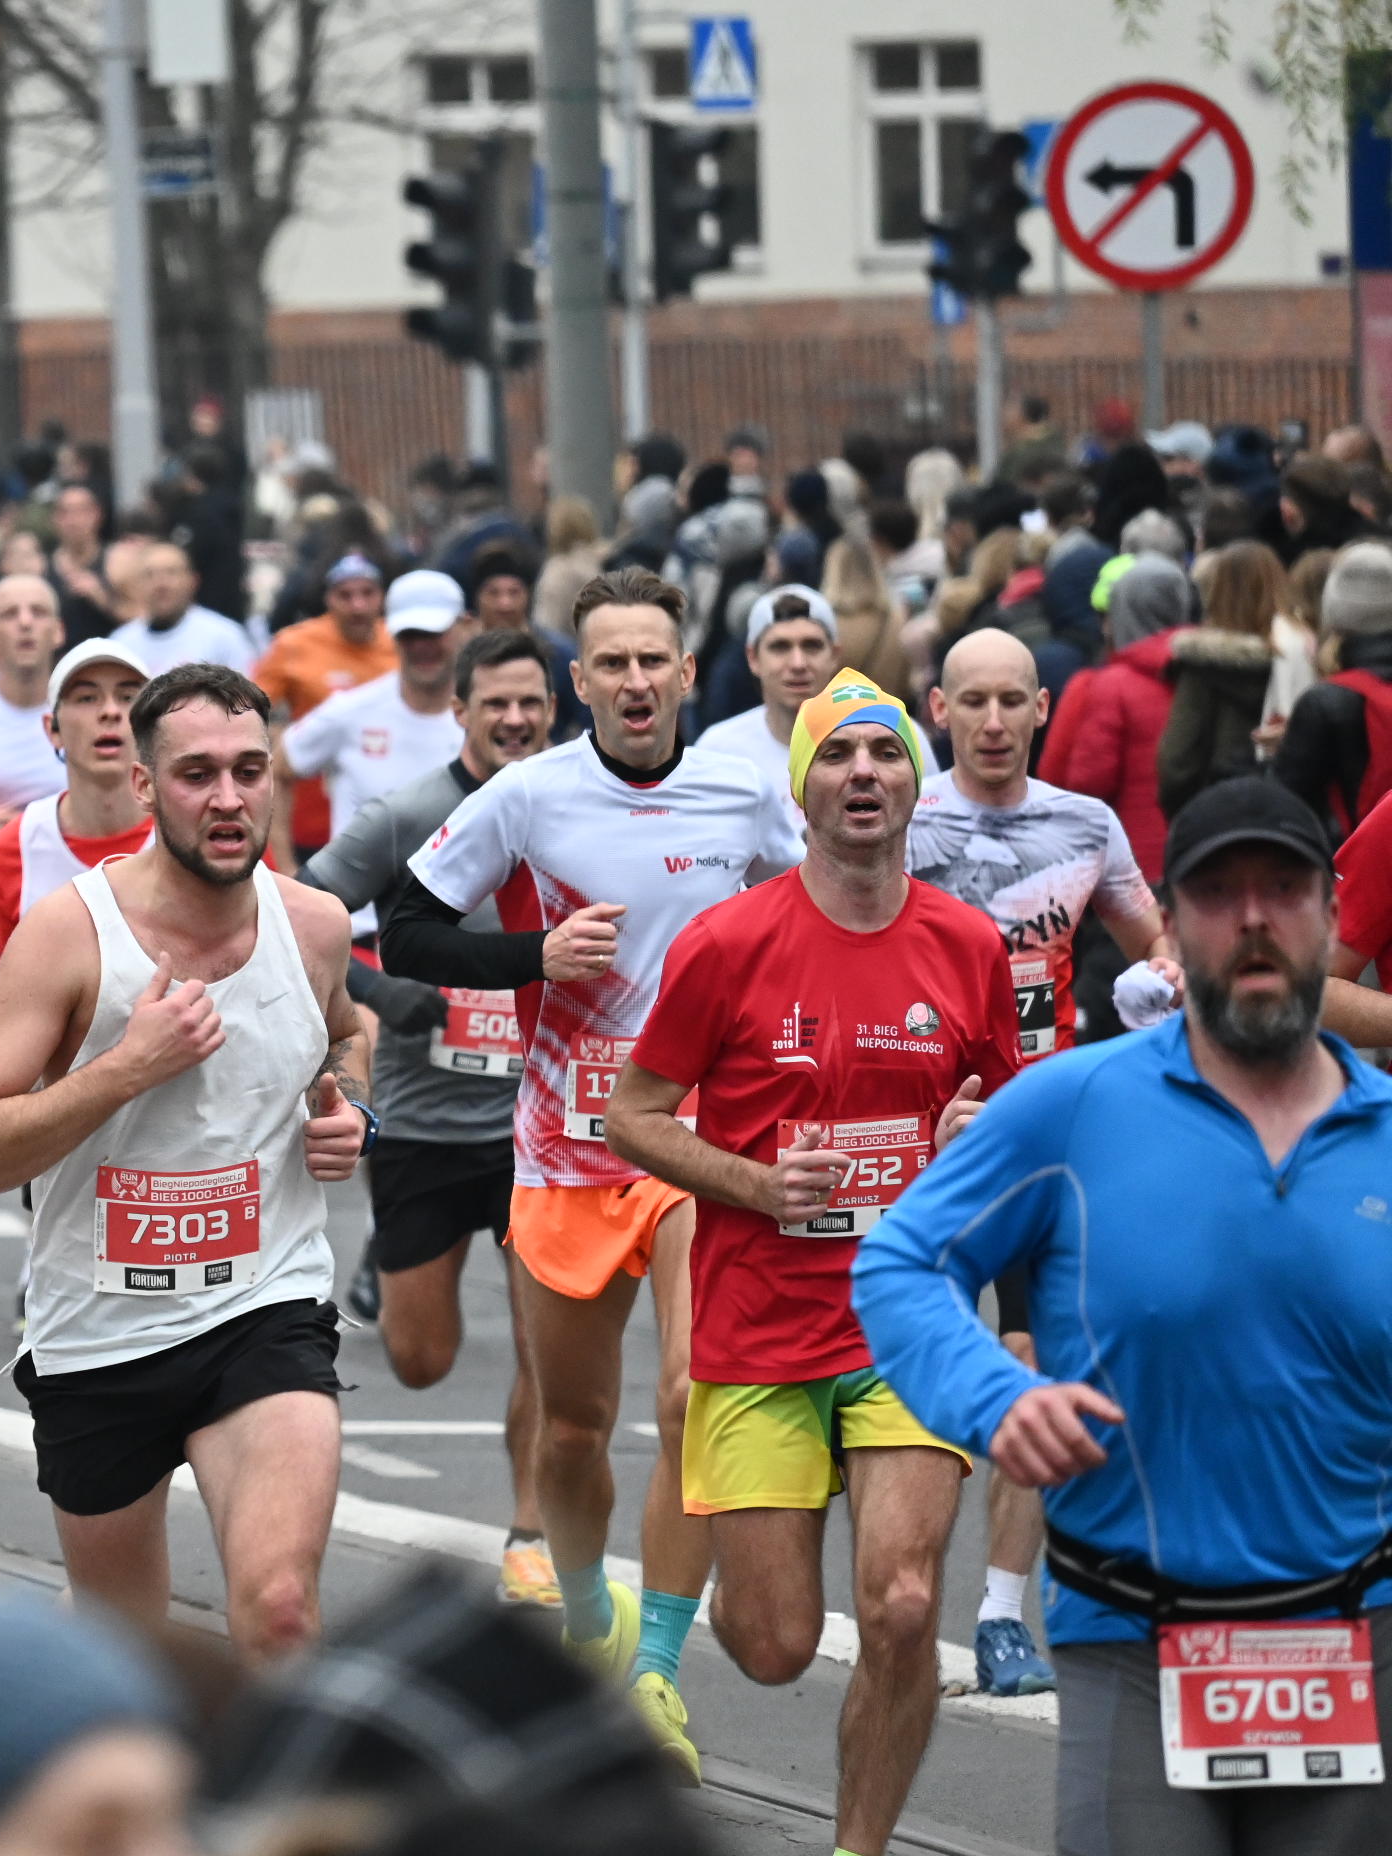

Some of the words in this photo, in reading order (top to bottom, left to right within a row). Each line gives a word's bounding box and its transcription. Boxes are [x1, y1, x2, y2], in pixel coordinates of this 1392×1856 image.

[696, 856, 729, 870] holding
[1001, 896, 1071, 954] ZYŃ
[1044, 990, 1053, 1003] A
[782, 1018, 793, 1028] 11
[856, 1023, 871, 1035] 31.
[874, 1025, 898, 1037] BIEG
[782, 1028, 793, 1038] 11
[772, 1040, 794, 1050] 2019
[856, 1037, 944, 1055] NIEPODLEGŁOŚCI
[833, 1137, 858, 1148] BIEG
[860, 1133, 919, 1147] 1000-LECIA
[917, 1155, 928, 1169] B
[120, 1172, 138, 1182] RUN
[829, 1155, 902, 1190] 752
[150, 1191, 180, 1202] BIEG
[181, 1183, 247, 1201] 1000-LECIA
[837, 1195, 880, 1206] DARIUSZ
[244, 1205, 256, 1220] B
[127, 1209, 229, 1246] 7303
[812, 1215, 849, 1230] FORTUNA
[163, 1252, 198, 1263] PIOTR
[130, 1271, 169, 1288] FORTUNA
[1203, 1677, 1335, 1724] 6706
